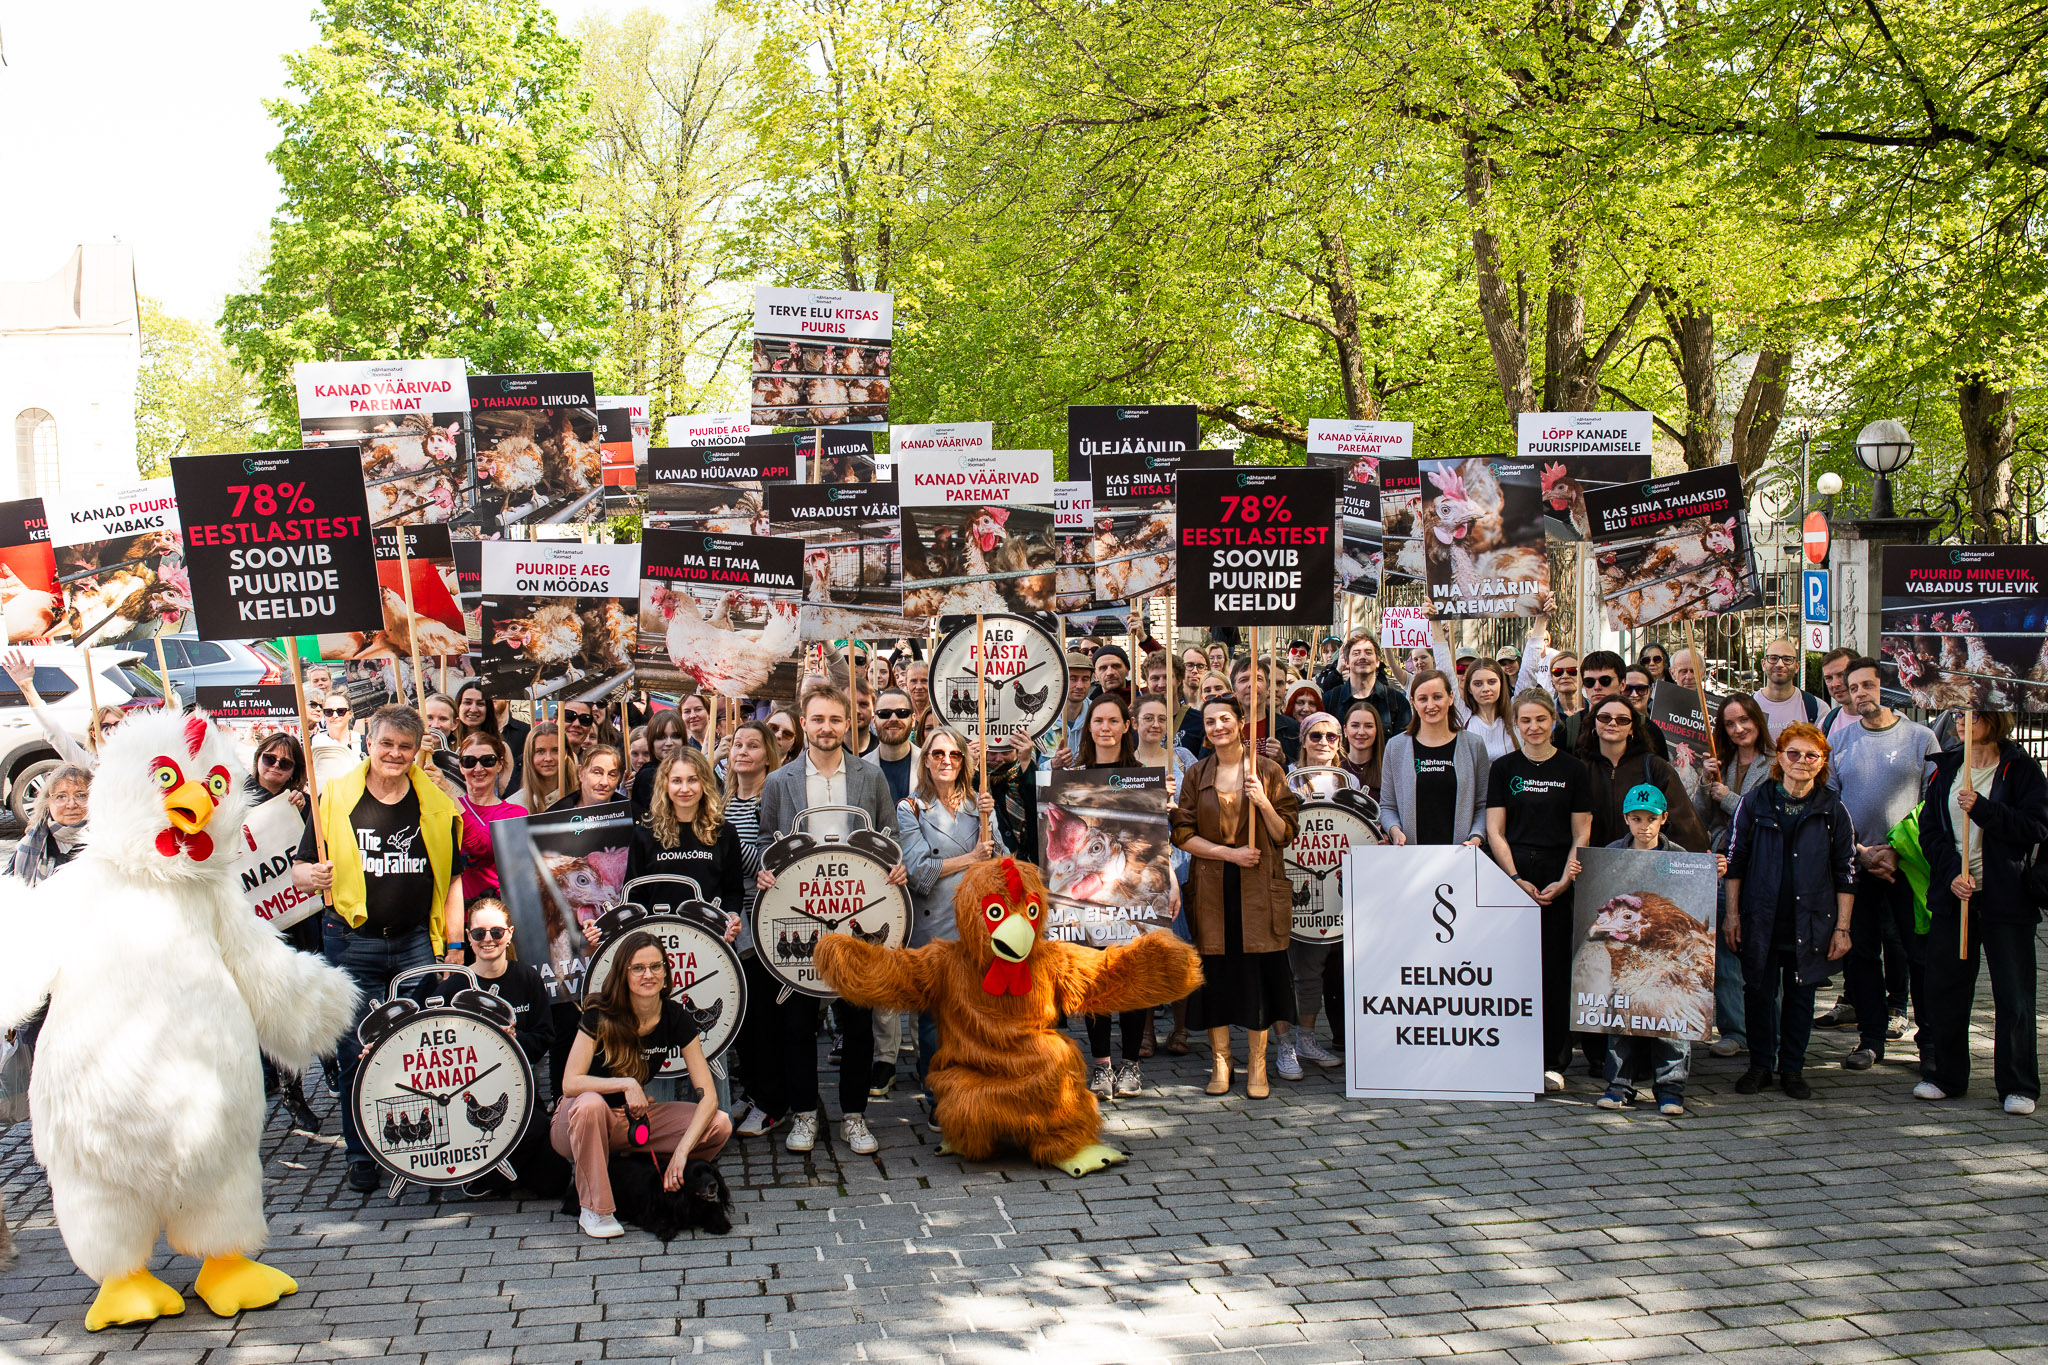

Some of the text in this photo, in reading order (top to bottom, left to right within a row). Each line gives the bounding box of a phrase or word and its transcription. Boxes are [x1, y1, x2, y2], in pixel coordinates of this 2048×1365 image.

[769, 305, 879, 321] TERVE ELU KITSAS
[801, 322, 846, 334] PUURIS
[315, 380, 452, 397] KANAD VÄÄRIVAD
[350, 398, 422, 412] PAREMAT
[482, 396, 538, 407] TAHAVAD
[542, 394, 589, 406] LIIKUDA
[689, 424, 750, 436] PUURIDE AEG
[1318, 432, 1402, 444] KANAD VÄÄRIVAD
[1542, 428, 1628, 440] LÕPP KANADE
[690, 438, 705, 447] ON
[828, 444, 868, 456] LIIKUDA
[901, 436, 982, 449] KANAD VÄÄRIVAD
[1080, 438, 1186, 456] ÜLEJÄÄNUD
[1337, 444, 1381, 454] PAREMAT
[1529, 442, 1641, 452] PUURISPIDAMISELE
[655, 466, 789, 480] KANAD HÜÜAVAD APPI
[914, 470, 1039, 486] KANAD VÄÄRIVAD
[1106, 475, 1129, 485] KAS
[1133, 474, 1162, 484] SINA
[1385, 477, 1419, 487] EI PUU
[946, 489, 1010, 501] PAREMAT
[1106, 485, 1171, 496] ELU KITSAS
[226, 481, 315, 517] 78%
[1344, 496, 1370, 508] TULEB
[1602, 488, 1726, 520] KAS SINA TAHAKSID
[70, 505, 125, 524] KANAD
[791, 503, 899, 518] VABADUST VÄÄR
[1220, 495, 1292, 523] 78%
[1604, 499, 1729, 531] ELU KITSAS PUURIS?
[104, 515, 164, 535] VABAKS
[188, 516, 361, 546] EESTLASTEST
[380, 534, 418, 545] TUEB
[1182, 526, 1329, 546] EESTLASTEST
[229, 544, 332, 570] SOOVIB
[684, 554, 760, 570] MA EI TAHA
[1212, 550, 1298, 567] SOOVIB
[516, 563, 610, 576] PUURIDE AEG
[647, 565, 795, 586] PIINATUD KANA MUNA
[1910, 569, 2035, 581] PUURID MINEVIK,
[228, 570, 340, 596] PUURIDE
[517, 577, 608, 592] ON MÖÖDAS
[1209, 571, 1302, 589] PUURIDE
[1905, 582, 2039, 594] VABADUS TULEVIK
[1433, 579, 1539, 598] MA VÄÄRIN
[1810, 576, 1823, 616] P
[238, 595, 336, 621] KEELDU
[1214, 593, 1296, 611] KEELDU
[1436, 600, 1516, 615] PAREMAT
[1385, 618, 1403, 628] THIS
[985, 630, 1013, 642] AEG
[1392, 629, 1431, 647] LEGAL
[1523, 780, 1565, 788] nähtamatud
[584, 810, 624, 823] nähtamatud
[584, 820, 610, 829] loomad
[1305, 819, 1334, 832] AEG
[356, 828, 381, 851] The
[1291, 833, 1350, 850] PÄÄSTA
[657, 850, 713, 861] LOOMASÕBER
[360, 852, 426, 877] DogFather
[816, 864, 848, 877] AEG
[1670, 862, 1711, 870] nähtamatud
[800, 878, 866, 897] PÄÄSTA
[805, 898, 863, 914] KANAD
[1048, 905, 1157, 923] MA EI TAHA
[1048, 924, 1141, 941] SIIN OLLA
[1401, 961, 1492, 986] EELNÕU
[1362, 996, 1532, 1017] KANAPUURIDE
[1578, 992, 1630, 1009] MA EI
[1576, 1008, 1688, 1033] JÕUA ENAM
[419, 1029, 457, 1047] AEG
[1396, 1026, 1499, 1046] KEELUKS
[402, 1046, 478, 1072] PÄÄSTA
[411, 1066, 476, 1091] KANAD
[410, 1145, 488, 1169] PUURIDEST
